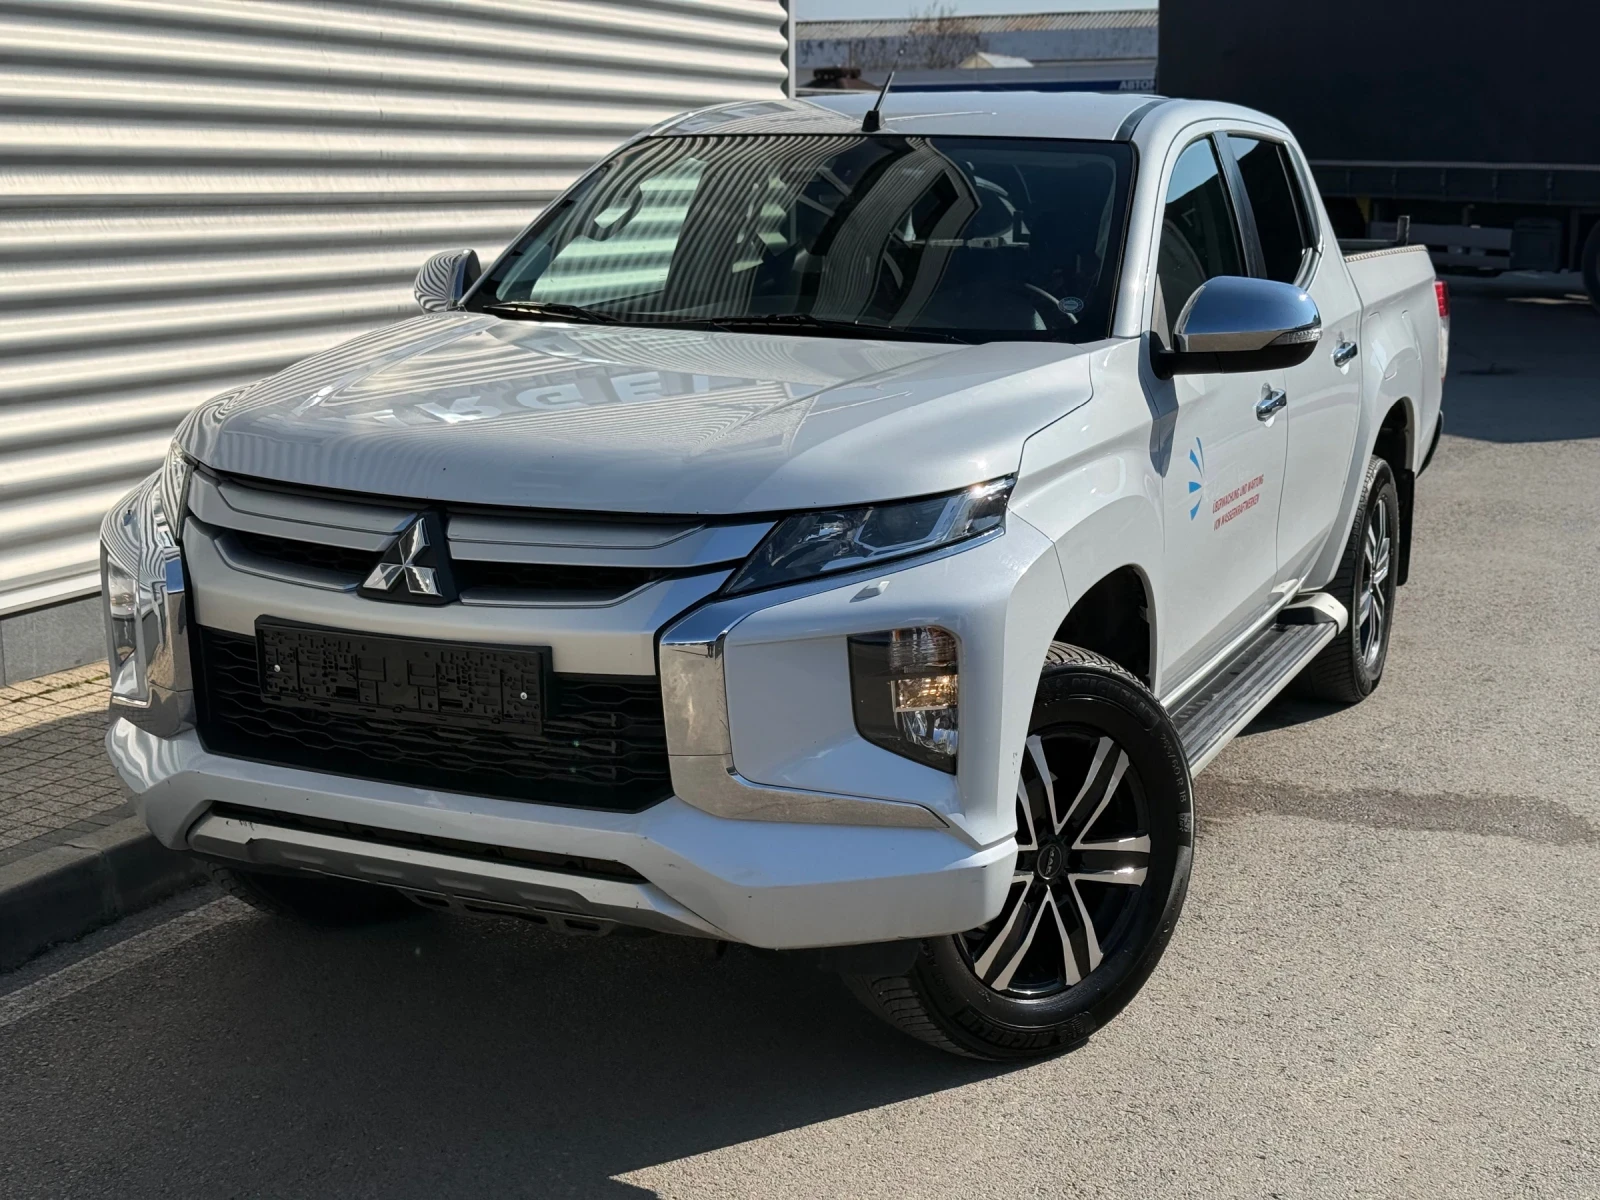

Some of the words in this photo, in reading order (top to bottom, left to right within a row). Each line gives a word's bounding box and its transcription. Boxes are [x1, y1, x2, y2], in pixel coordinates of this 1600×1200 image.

[1247, 473, 1264, 492] WARTUNG
[1213, 516, 1221, 531] VON
[1179, 791, 1188, 803] 18
